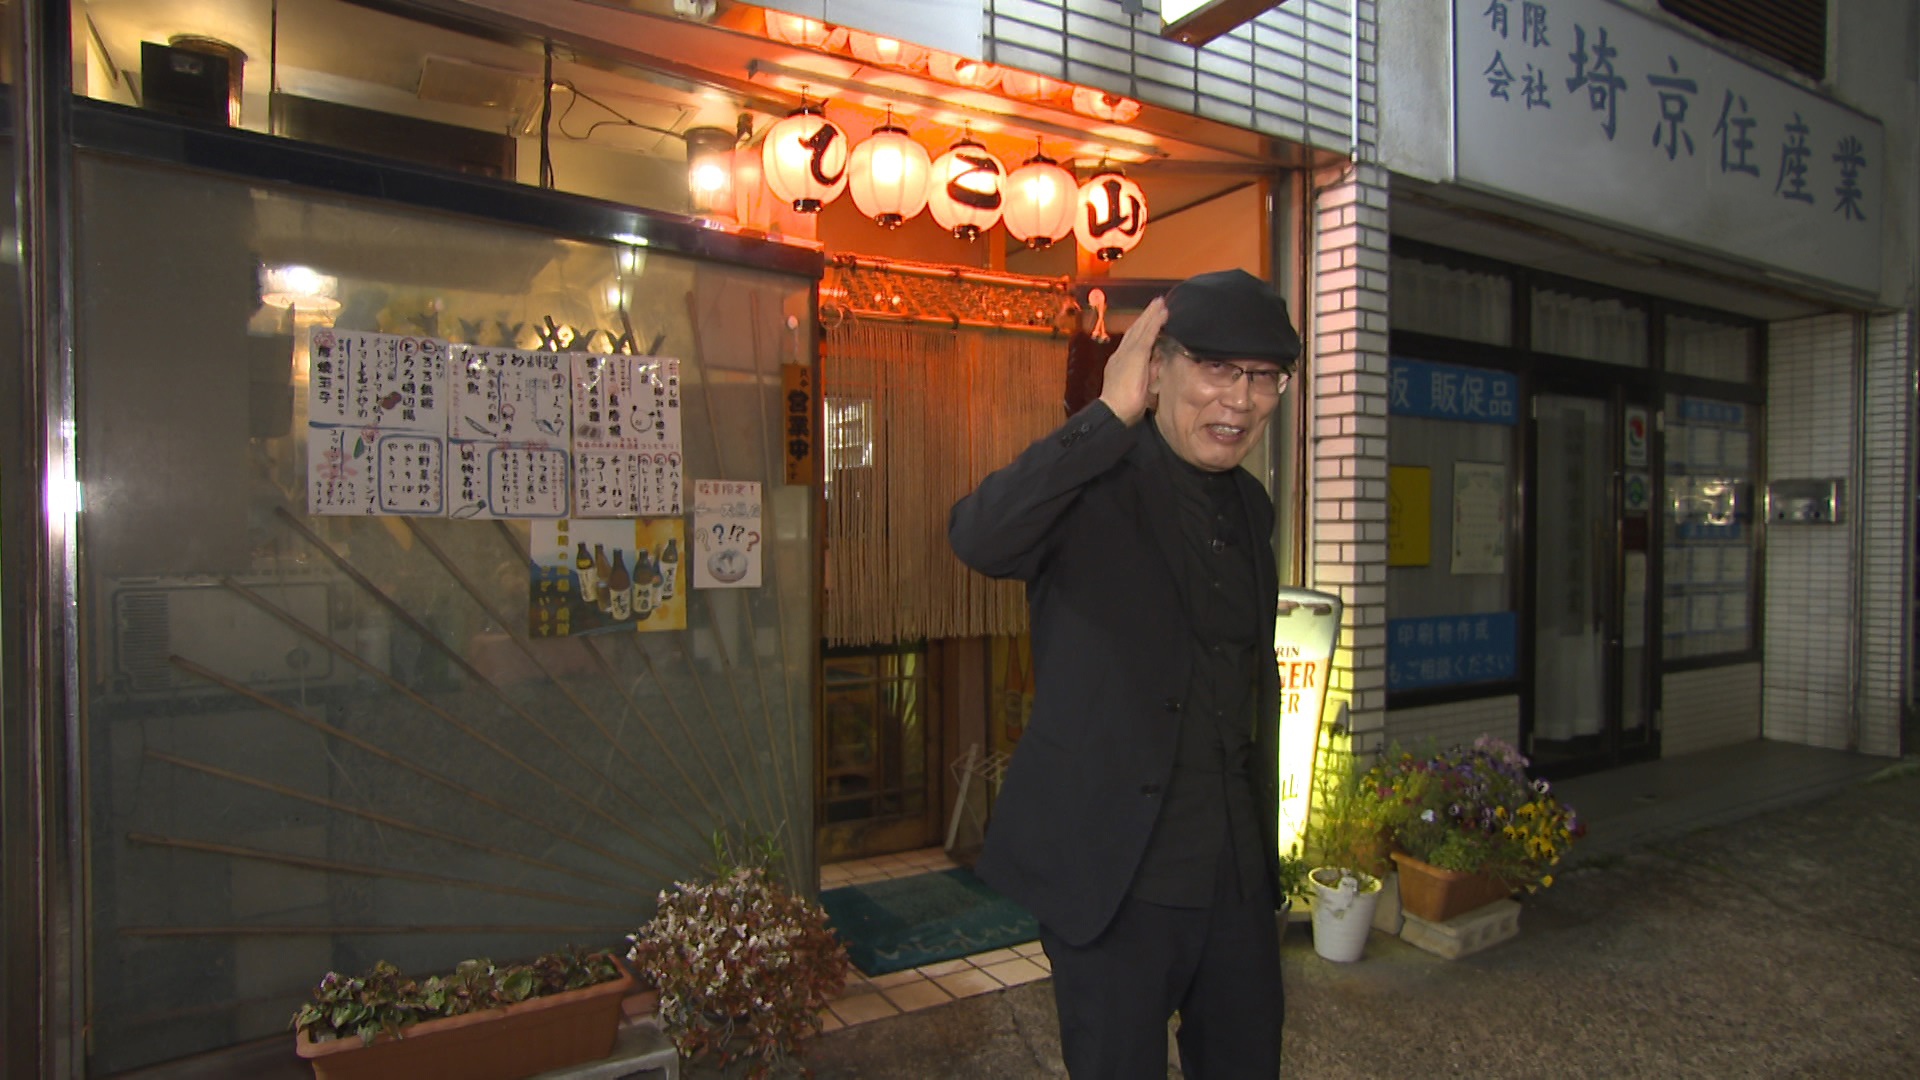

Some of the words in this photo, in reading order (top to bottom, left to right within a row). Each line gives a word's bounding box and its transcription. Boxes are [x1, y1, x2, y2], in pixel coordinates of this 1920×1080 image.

[1484, 0, 1552, 47] 有限
[1484, 50, 1552, 110] 会社
[1565, 23, 1867, 222] 埼京住産業
[1430, 370, 1513, 417] 販促品
[788, 388, 810, 462] 営業中
[595, 457, 607, 508] ラーメン
[611, 455, 623, 508] チャーハン
[1275, 646, 1300, 658] RIN
[1278, 661, 1316, 689] GER
[1388, 652, 1512, 685] もご相談ください
